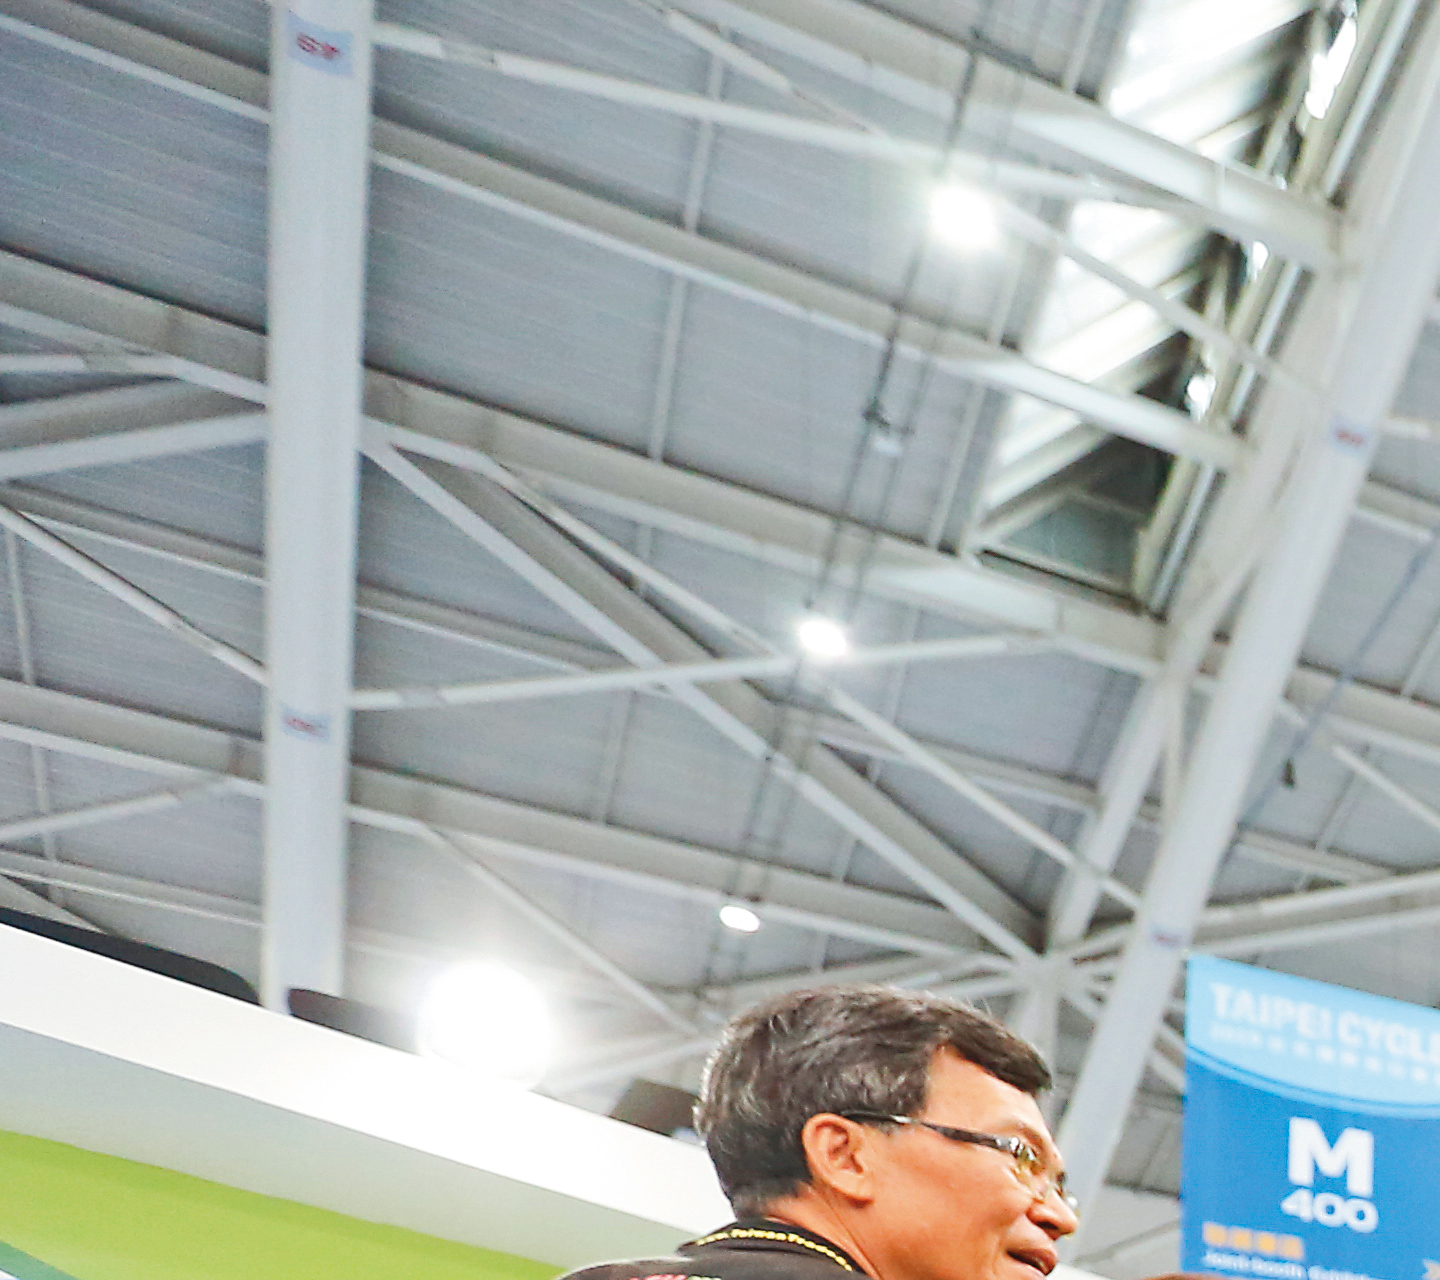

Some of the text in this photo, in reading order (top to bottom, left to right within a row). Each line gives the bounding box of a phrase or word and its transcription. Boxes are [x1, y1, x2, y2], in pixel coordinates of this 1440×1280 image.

[1210, 982, 1333, 1040] TAIPEI
[1288, 1116, 1374, 1198] M
[1279, 1188, 1379, 1234] 400
